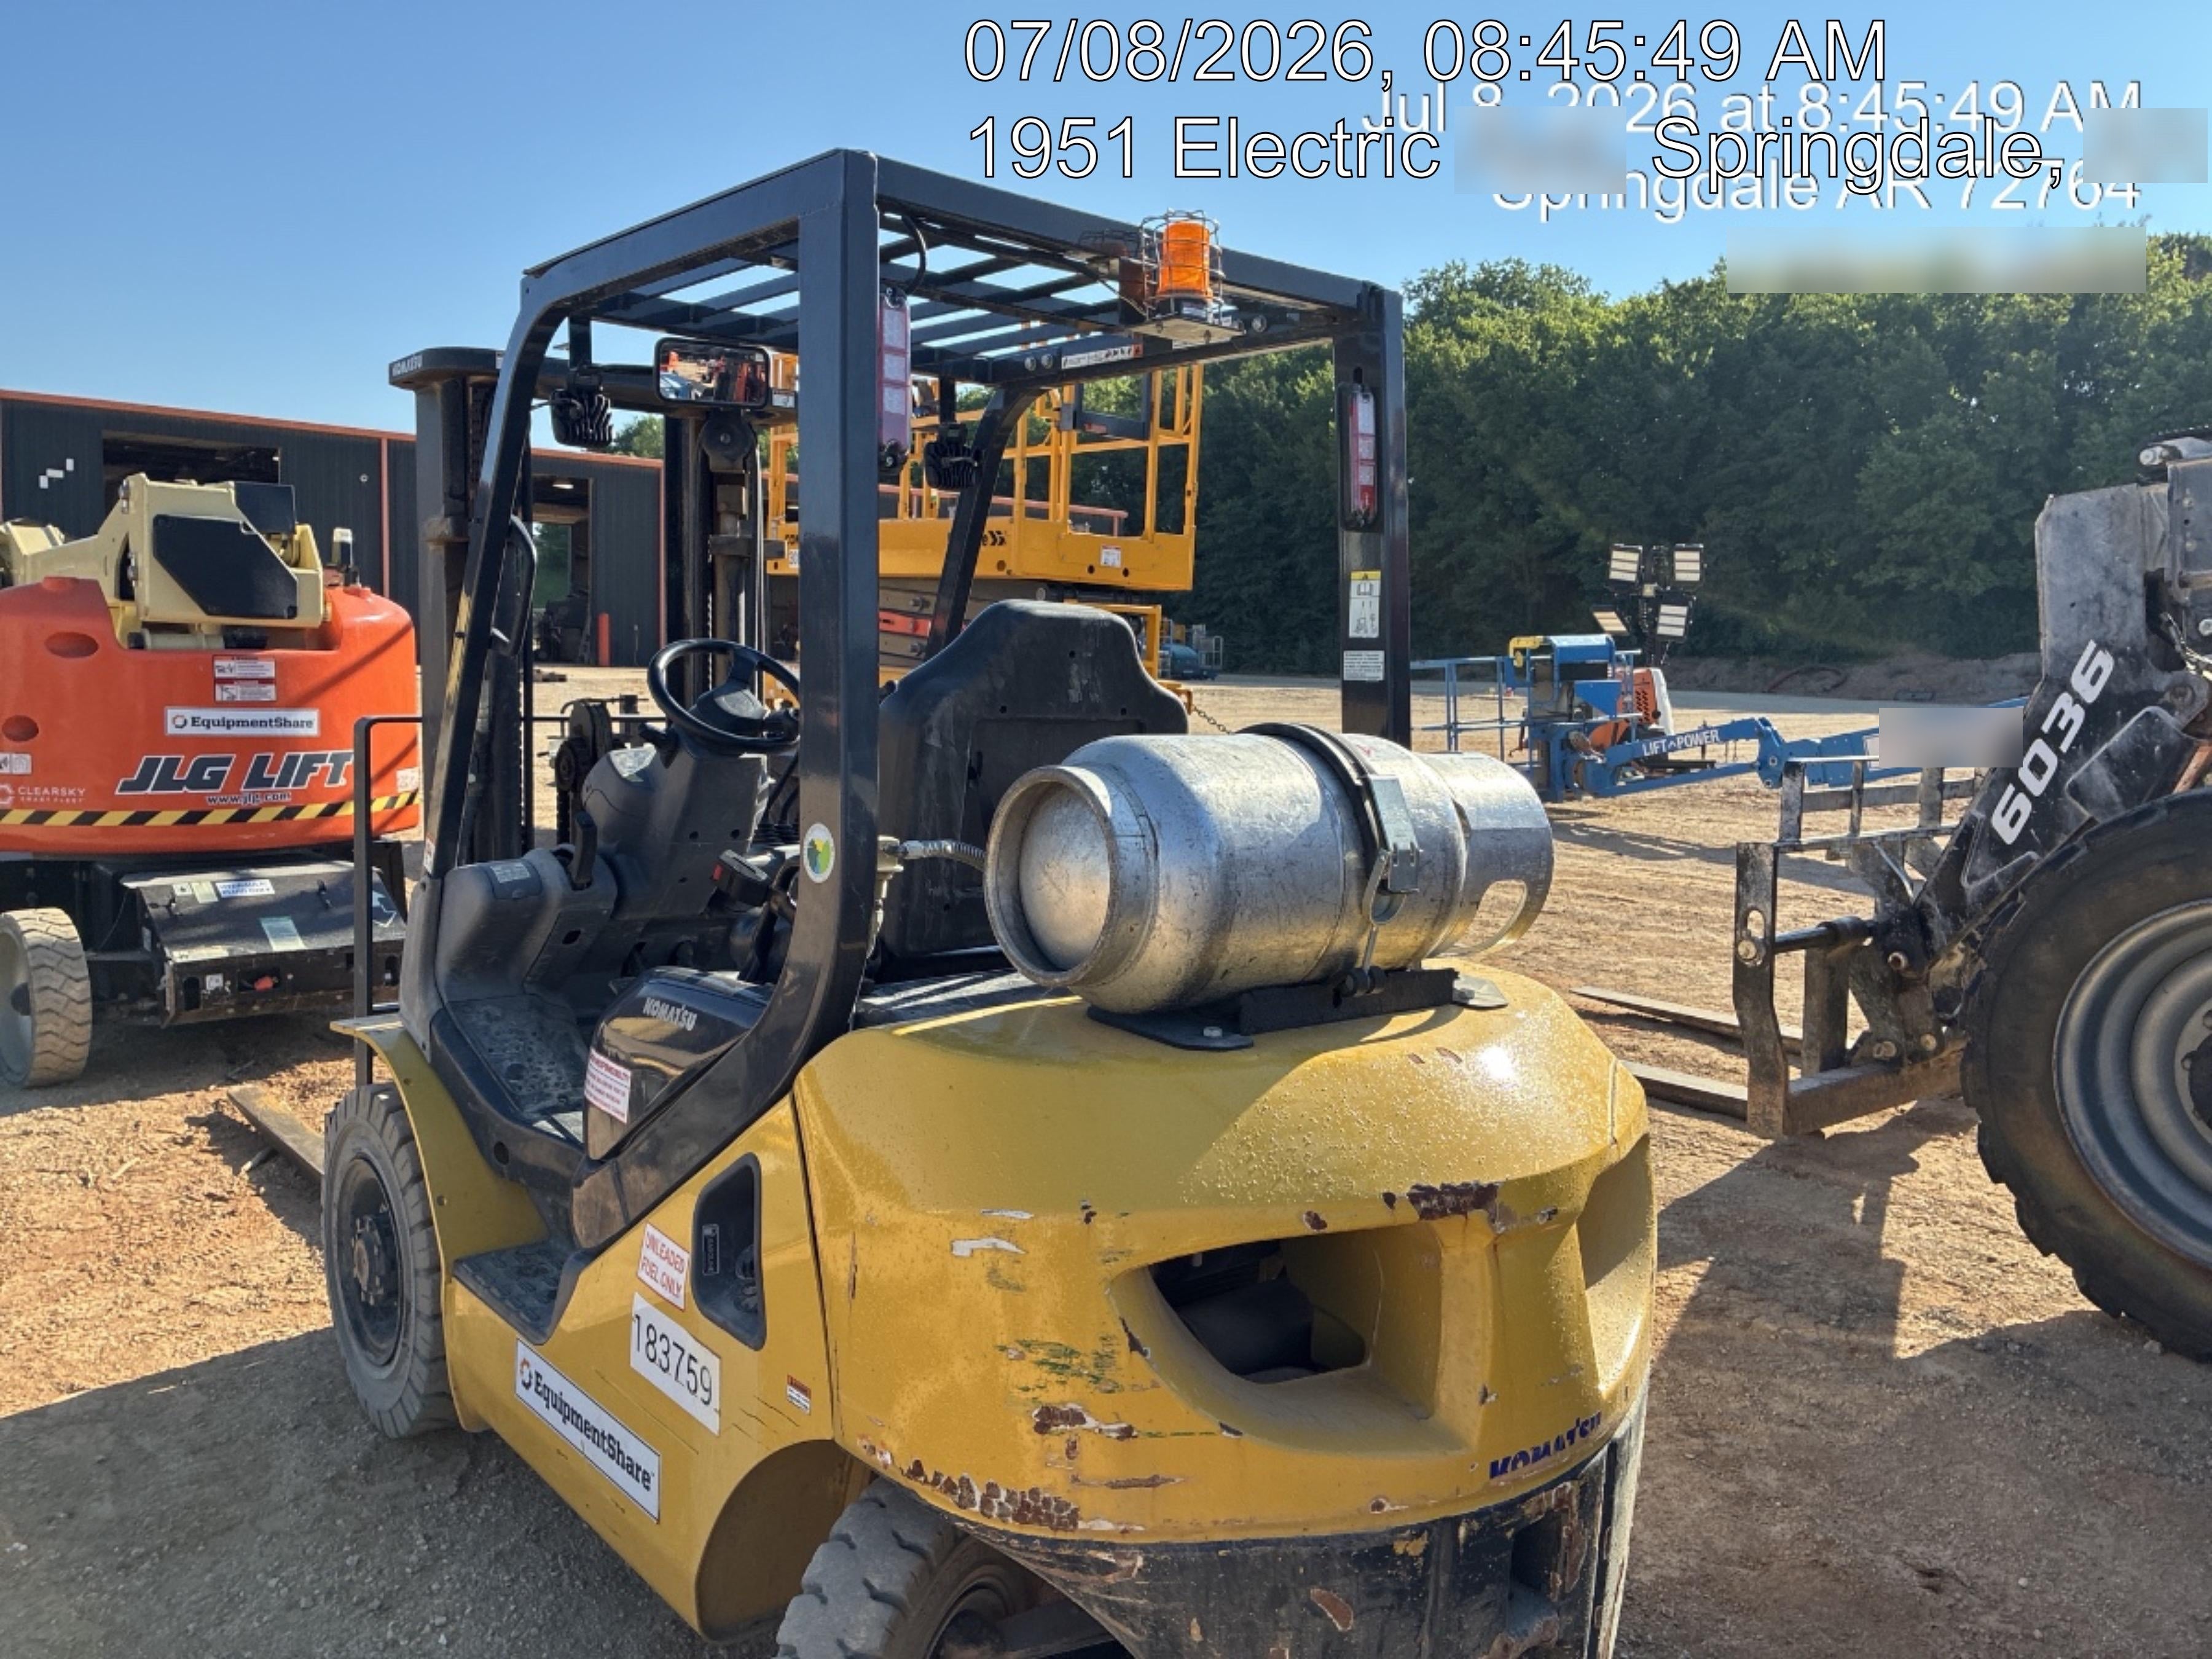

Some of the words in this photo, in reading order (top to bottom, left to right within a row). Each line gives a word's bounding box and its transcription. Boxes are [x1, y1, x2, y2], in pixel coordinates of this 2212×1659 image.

[190, 716, 314, 730] EquipmentShare
[1642, 739, 1667, 756] LIFT
[1676, 729, 1720, 750] POWER
[1991, 640, 2114, 845] 6036
[18, 786, 86, 797] CLEARSKY
[115, 755, 237, 794] JLG
[241, 751, 355, 791] LIFT
[206, 792, 291, 805] www.jlg.com
[643, 997, 697, 1031] KOMATSU
[646, 1233, 684, 1274] UNLEADED
[641, 1257, 659, 1285] FUEL
[660, 1271, 683, 1298] ONLY
[635, 1314, 713, 1406] 183759
[534, 1370, 651, 1492] EquipmentShare
